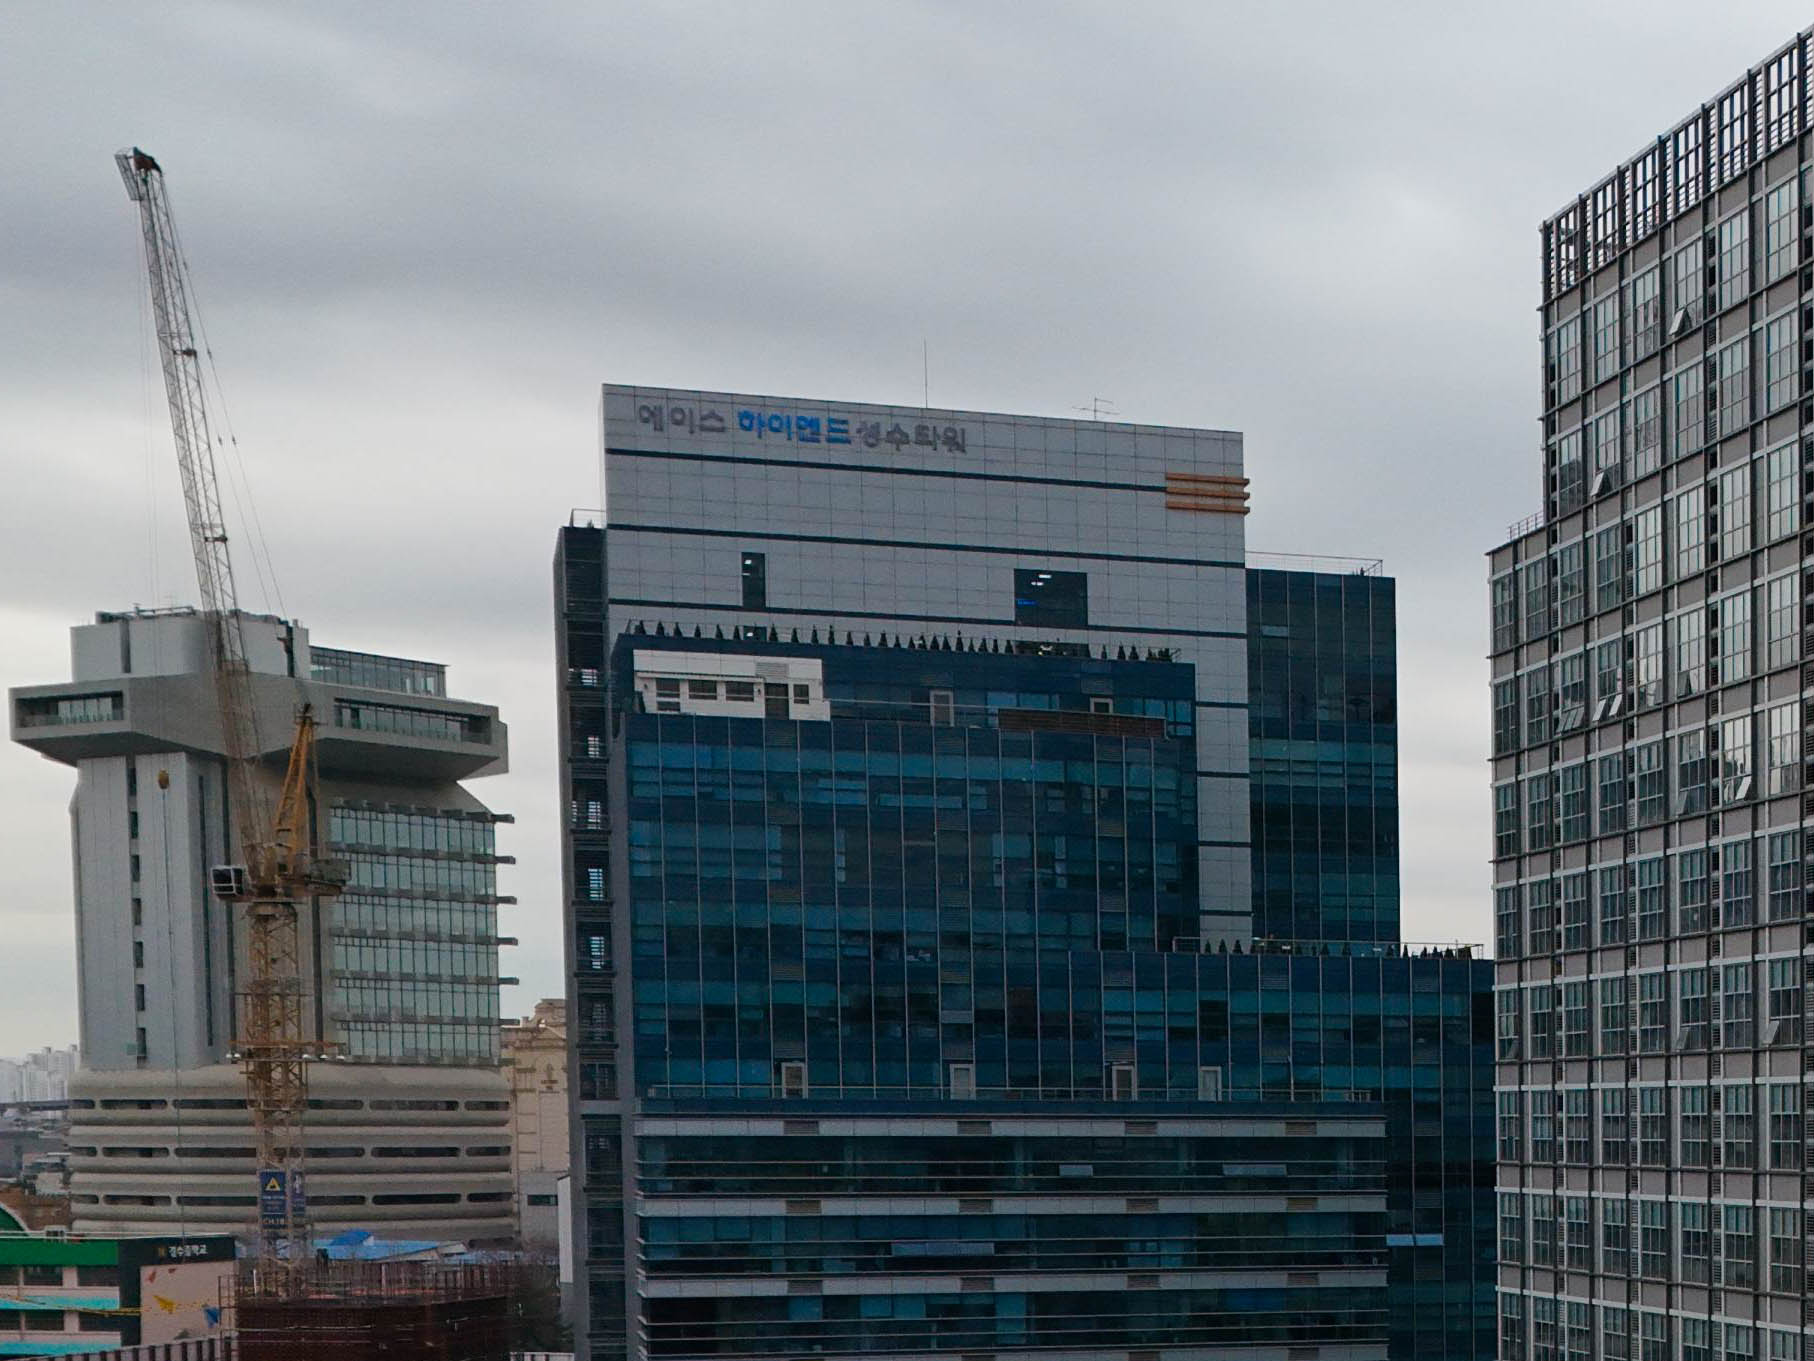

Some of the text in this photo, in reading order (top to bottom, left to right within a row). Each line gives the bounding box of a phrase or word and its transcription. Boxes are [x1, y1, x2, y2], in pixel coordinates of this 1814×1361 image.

[638, 404, 967, 455] 에이스 하이엔드 성수타워
